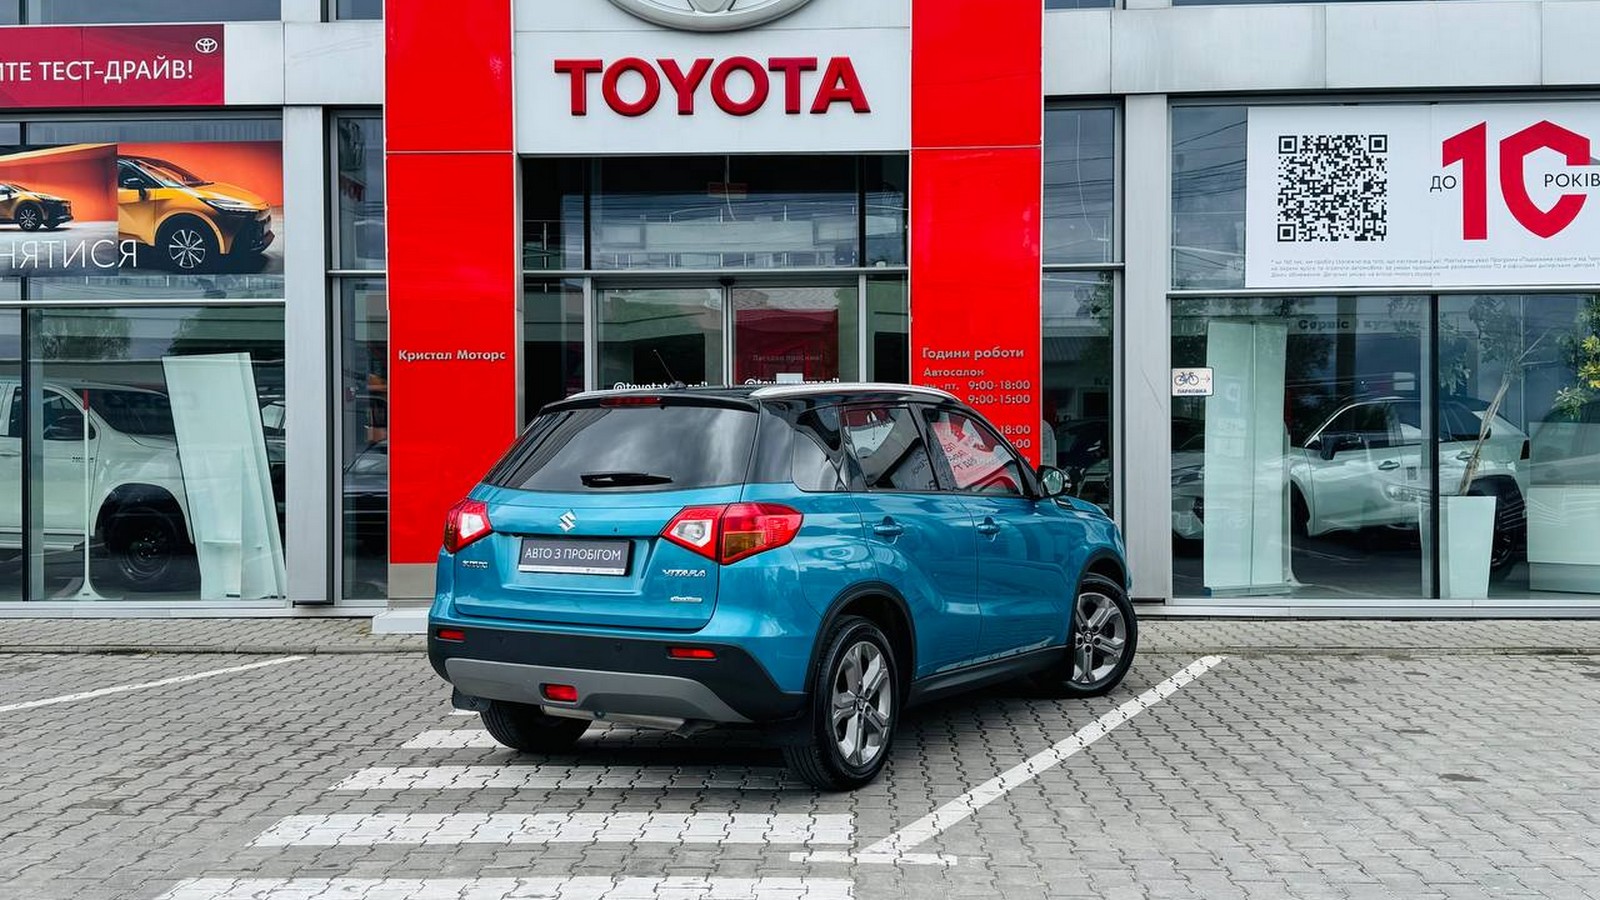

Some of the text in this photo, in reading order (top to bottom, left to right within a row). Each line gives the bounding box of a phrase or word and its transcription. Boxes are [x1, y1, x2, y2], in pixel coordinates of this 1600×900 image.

[39, 55, 193, 84] ТЕСТ-ДРАЙВ!
[554, 56, 871, 117] TOYOTA
[1430, 175, 1457, 192] ДО
[1545, 173, 1600, 187] РОКІВ
[398, 349, 506, 362] Кристал Моторс
[922, 346, 1024, 360] Години роботи
[923, 367, 985, 377] Автосалон
[524, 544, 622, 561] АВТО З ПРОБІГОМ
